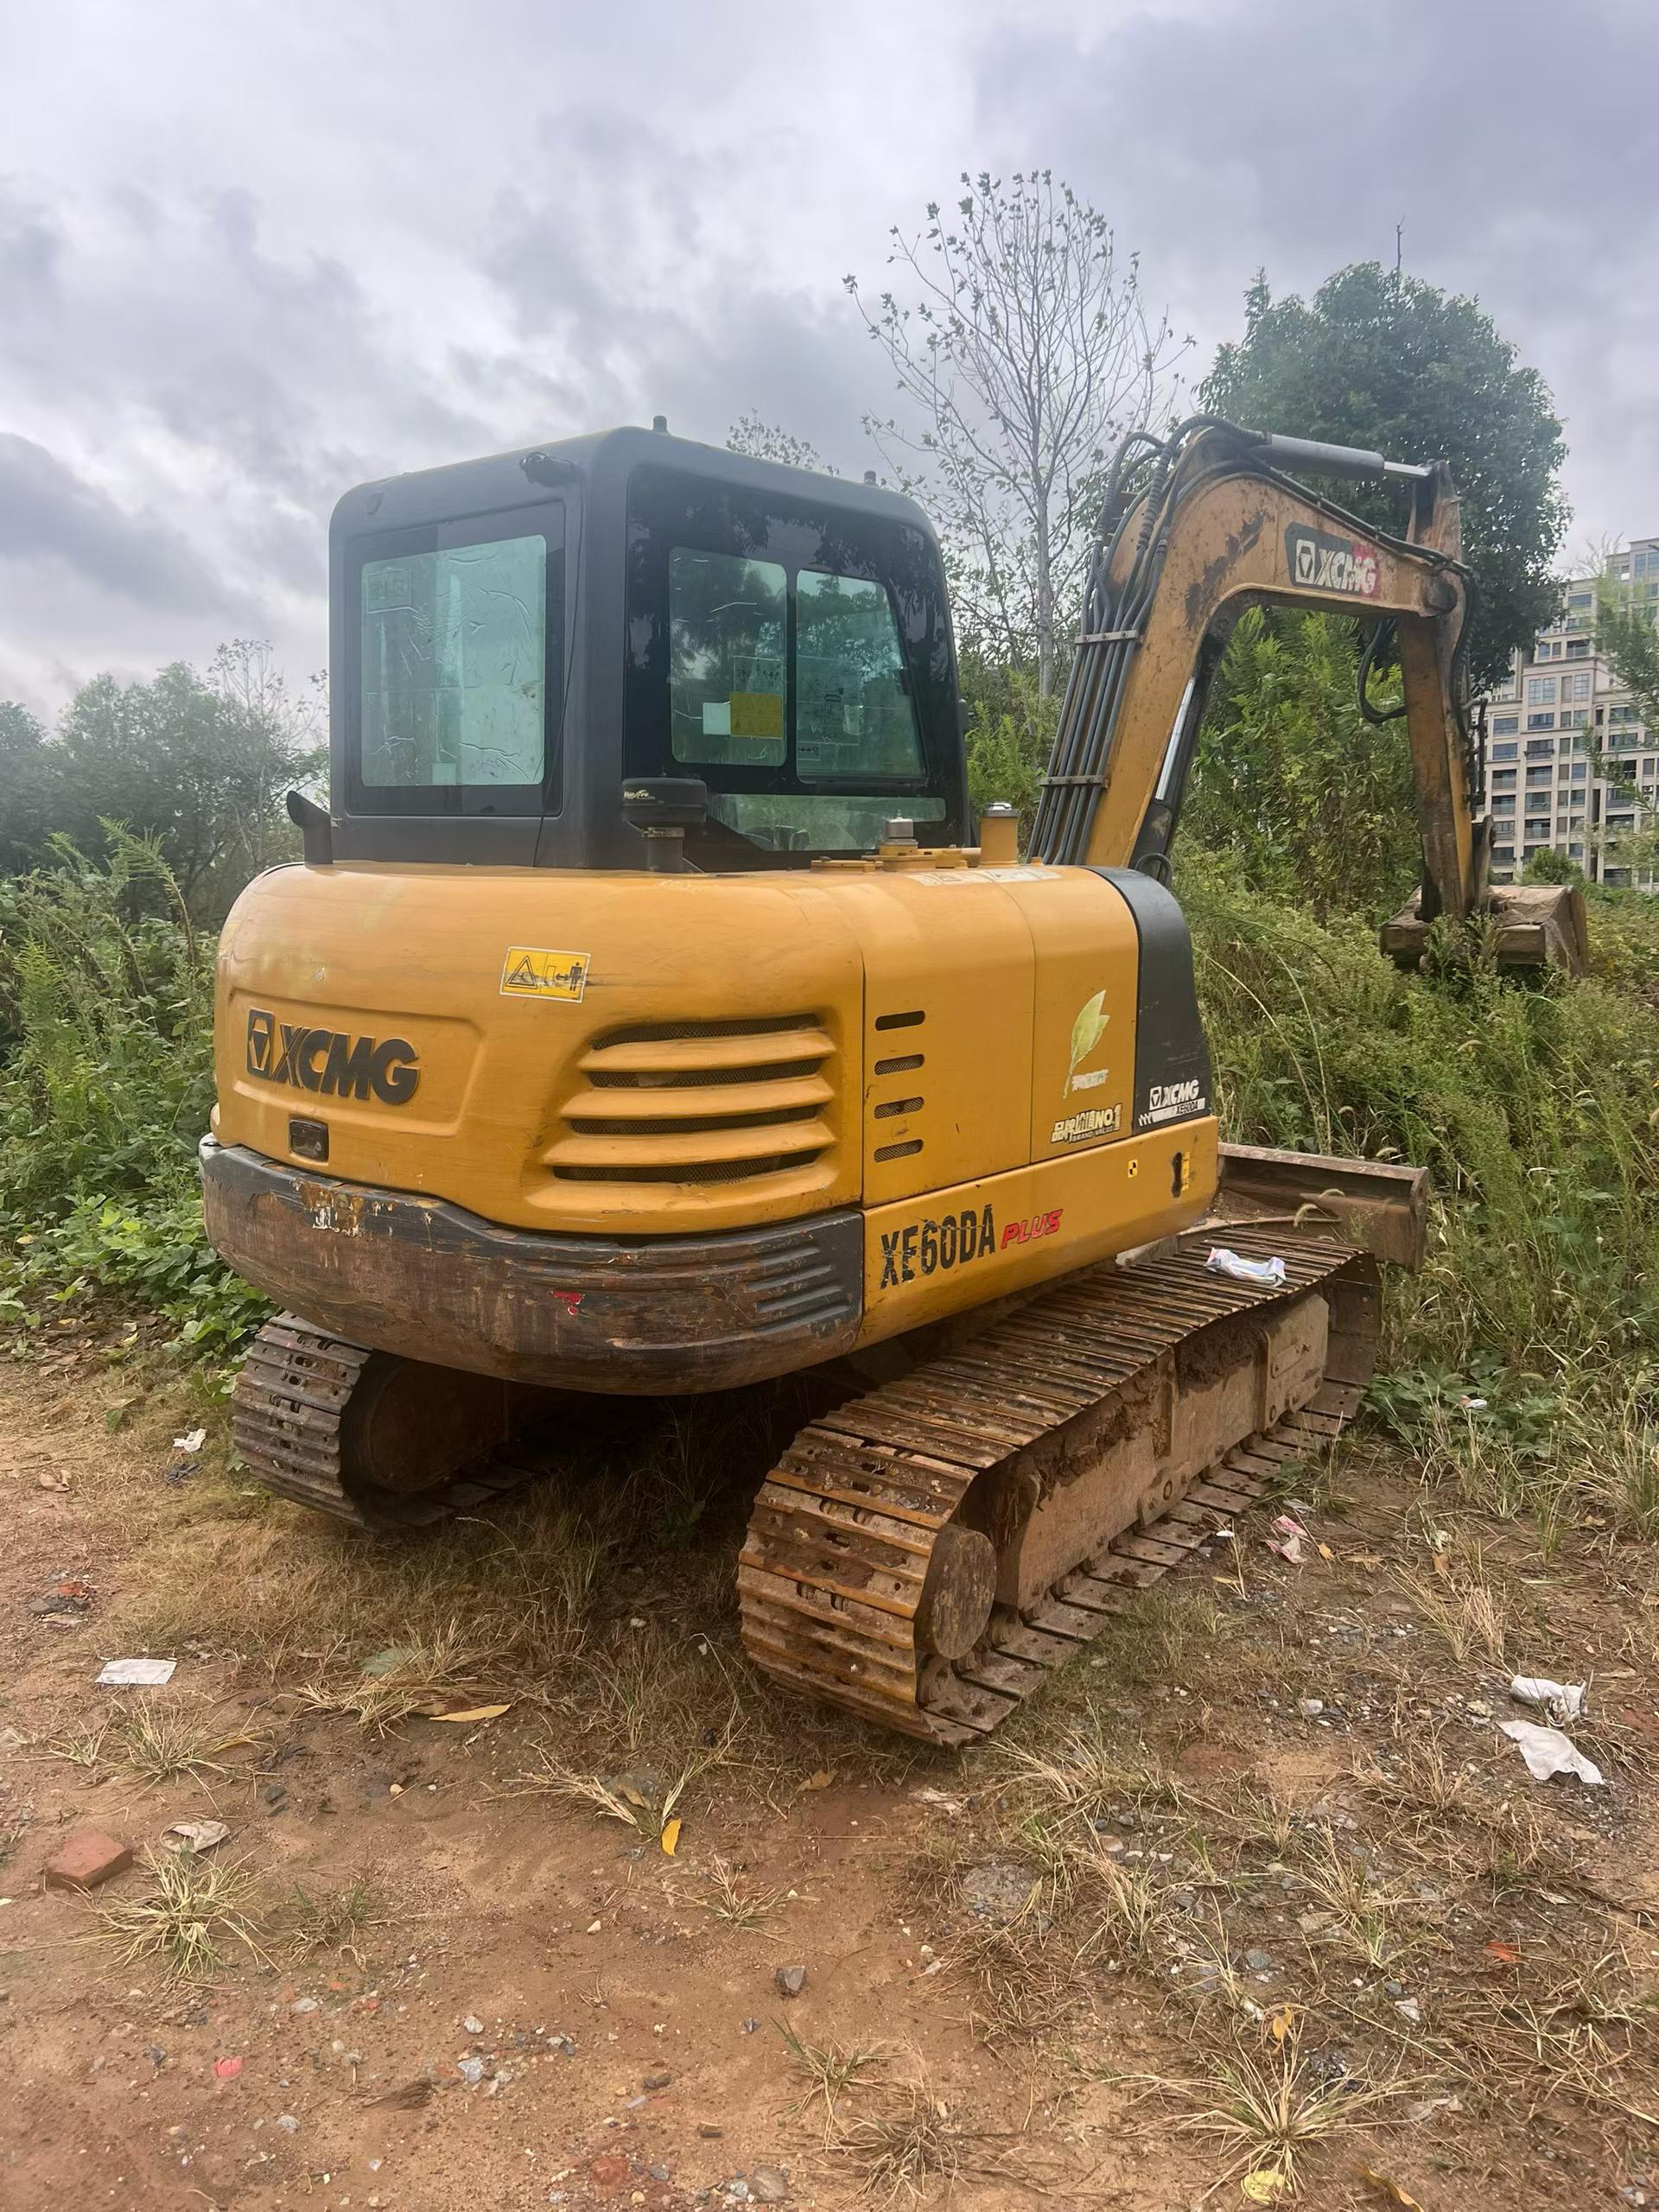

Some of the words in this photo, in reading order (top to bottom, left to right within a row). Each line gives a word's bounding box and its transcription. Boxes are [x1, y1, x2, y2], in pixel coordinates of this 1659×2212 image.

[1313, 548, 1377, 594] XCMG
[271, 1023, 421, 1105] XCMG
[1160, 1079, 1200, 1107] XCMG
[880, 1204, 996, 1291] XE60DA
[1001, 1208, 1064, 1249] PLUS
